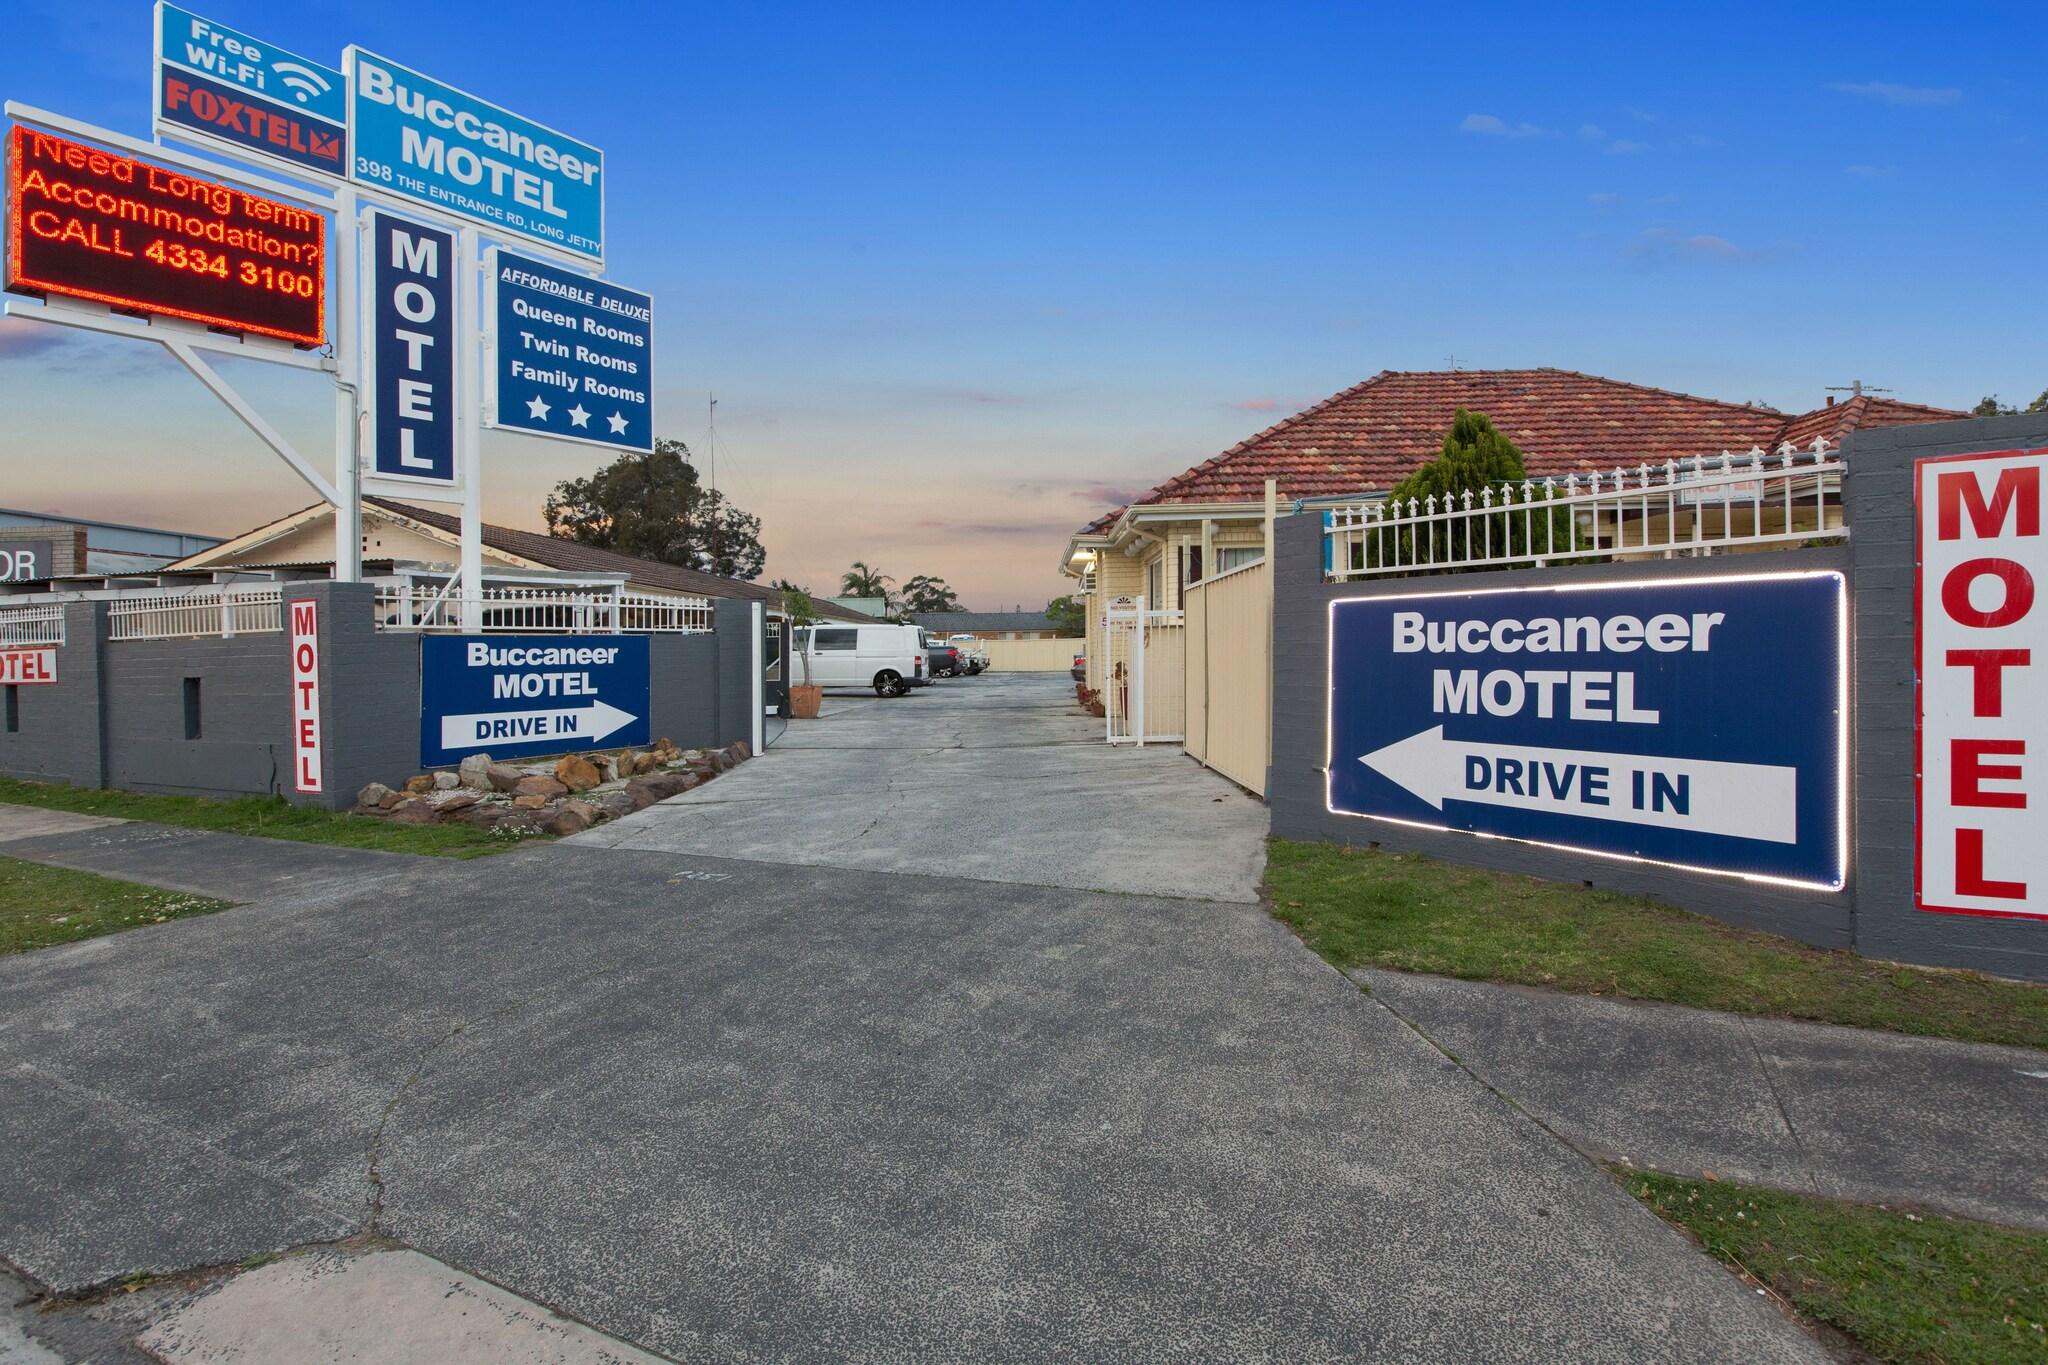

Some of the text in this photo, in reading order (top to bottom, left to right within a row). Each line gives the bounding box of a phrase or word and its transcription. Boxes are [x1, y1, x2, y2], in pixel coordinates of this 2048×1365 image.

[185, 42, 265, 89] Wi-Fi
[191, 19, 262, 63] Free
[166, 78, 306, 153] FOXTEL
[359, 60, 599, 186] Buccaneer
[32, 135, 311, 232] Need Long term
[402, 126, 567, 219] MOTEL
[21, 169, 319, 266] Accommodation?
[356, 156, 601, 253] 398 THE ENTRANCE RD, LONG JETTY
[29, 210, 313, 298] CALL 4334 3100
[501, 267, 650, 322] AFFORDABLE DELUXE
[512, 298, 644, 347] Queen Rooms
[391, 228, 438, 470] MOTEL
[520, 331, 638, 374] Twin Rooms
[512, 360, 645, 404] Family Rooms
[467, 642, 619, 667] Buccaneer
[1393, 612, 1726, 653] Buccaneer
[294, 606, 317, 786] MOTEL
[493, 672, 598, 699] MOTEL
[1433, 669, 1660, 724] MOTEL
[1938, 466, 2040, 900] MOTEL
[476, 715, 577, 740] DRIVE IN
[1465, 755, 1690, 816] DRIVE IN
